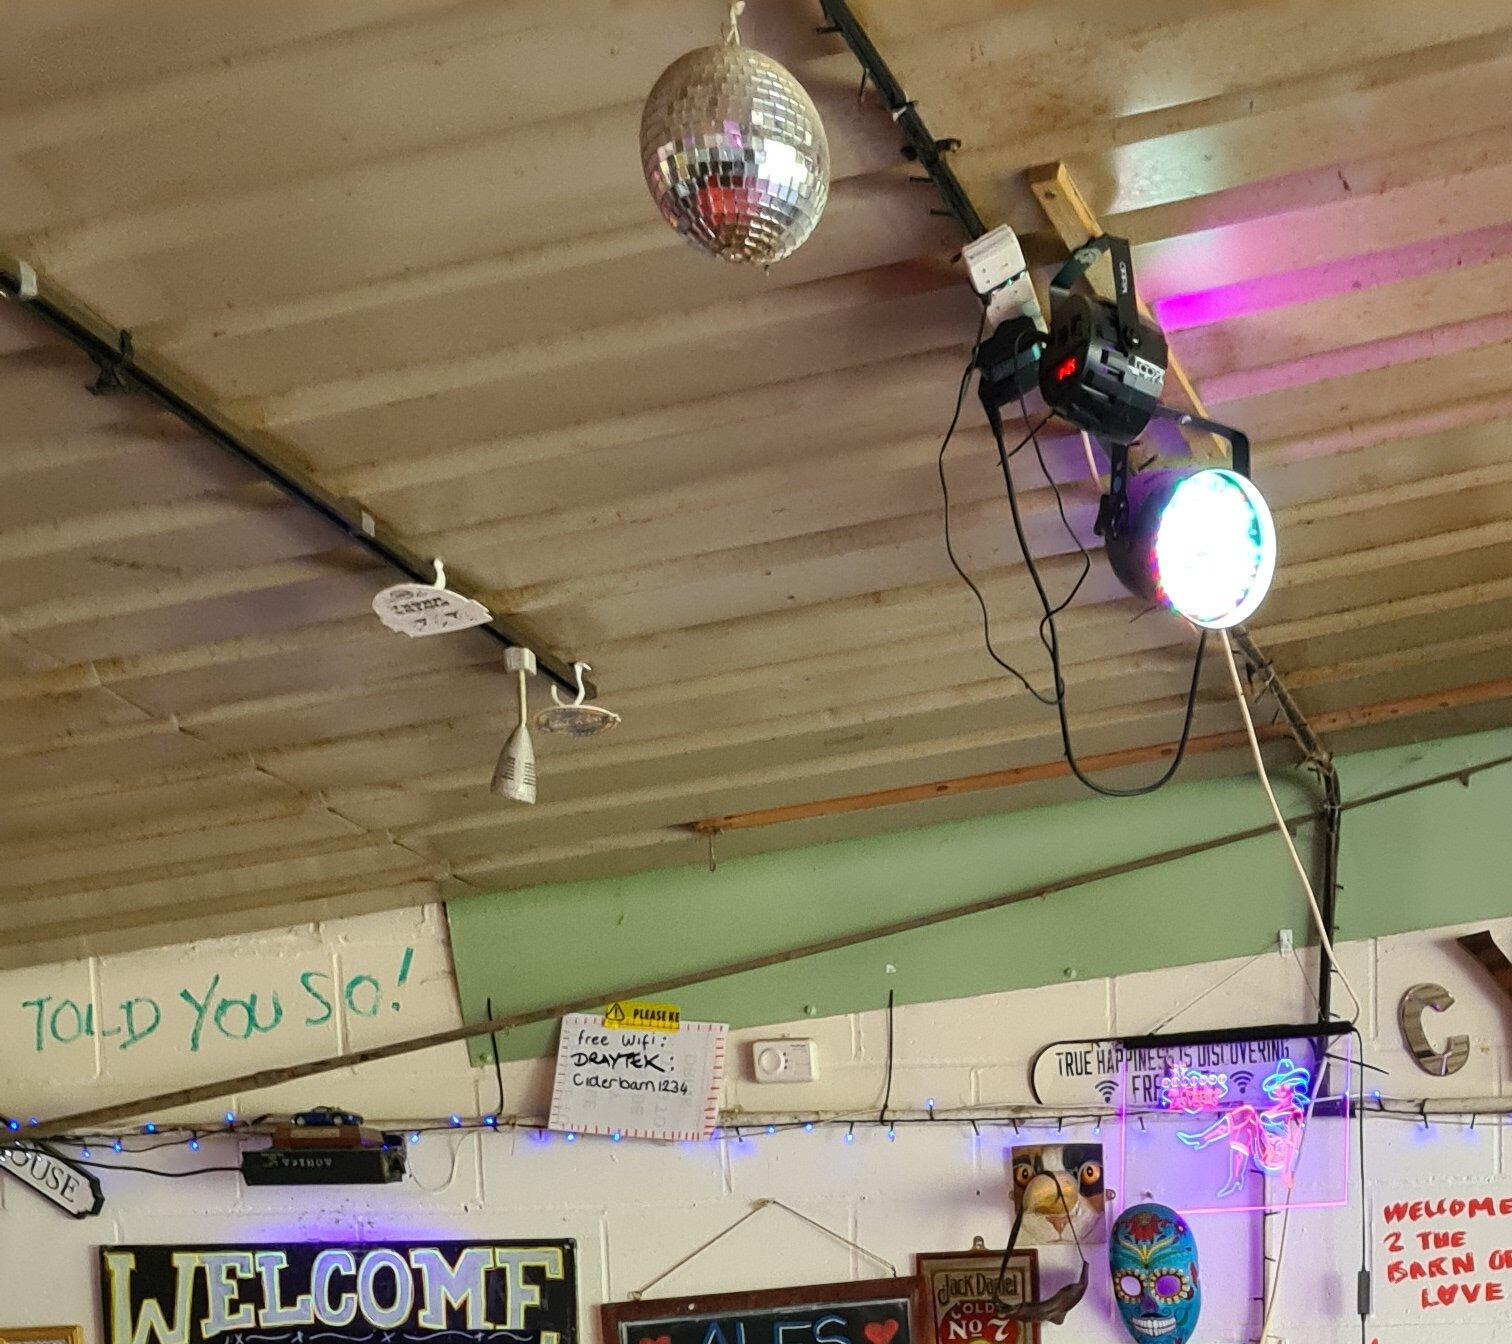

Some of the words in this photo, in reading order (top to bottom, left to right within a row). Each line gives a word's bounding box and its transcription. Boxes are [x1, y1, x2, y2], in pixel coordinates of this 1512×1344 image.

[22, 993, 162, 1052] TOLD
[179, 973, 283, 1054] YOU
[301, 947, 415, 1026] SO!
[632, 1007, 667, 1021] PLEASE
[577, 1029, 610, 1047] free
[1054, 1051, 1093, 1078] TRUE
[1383, 1231, 1405, 1253] 2
[1416, 1230, 1467, 1251] THE
[1386, 1252, 1476, 1284] BARN
[937, 1272, 975, 1306] Jack
[1420, 1281, 1506, 1310] LOVE
